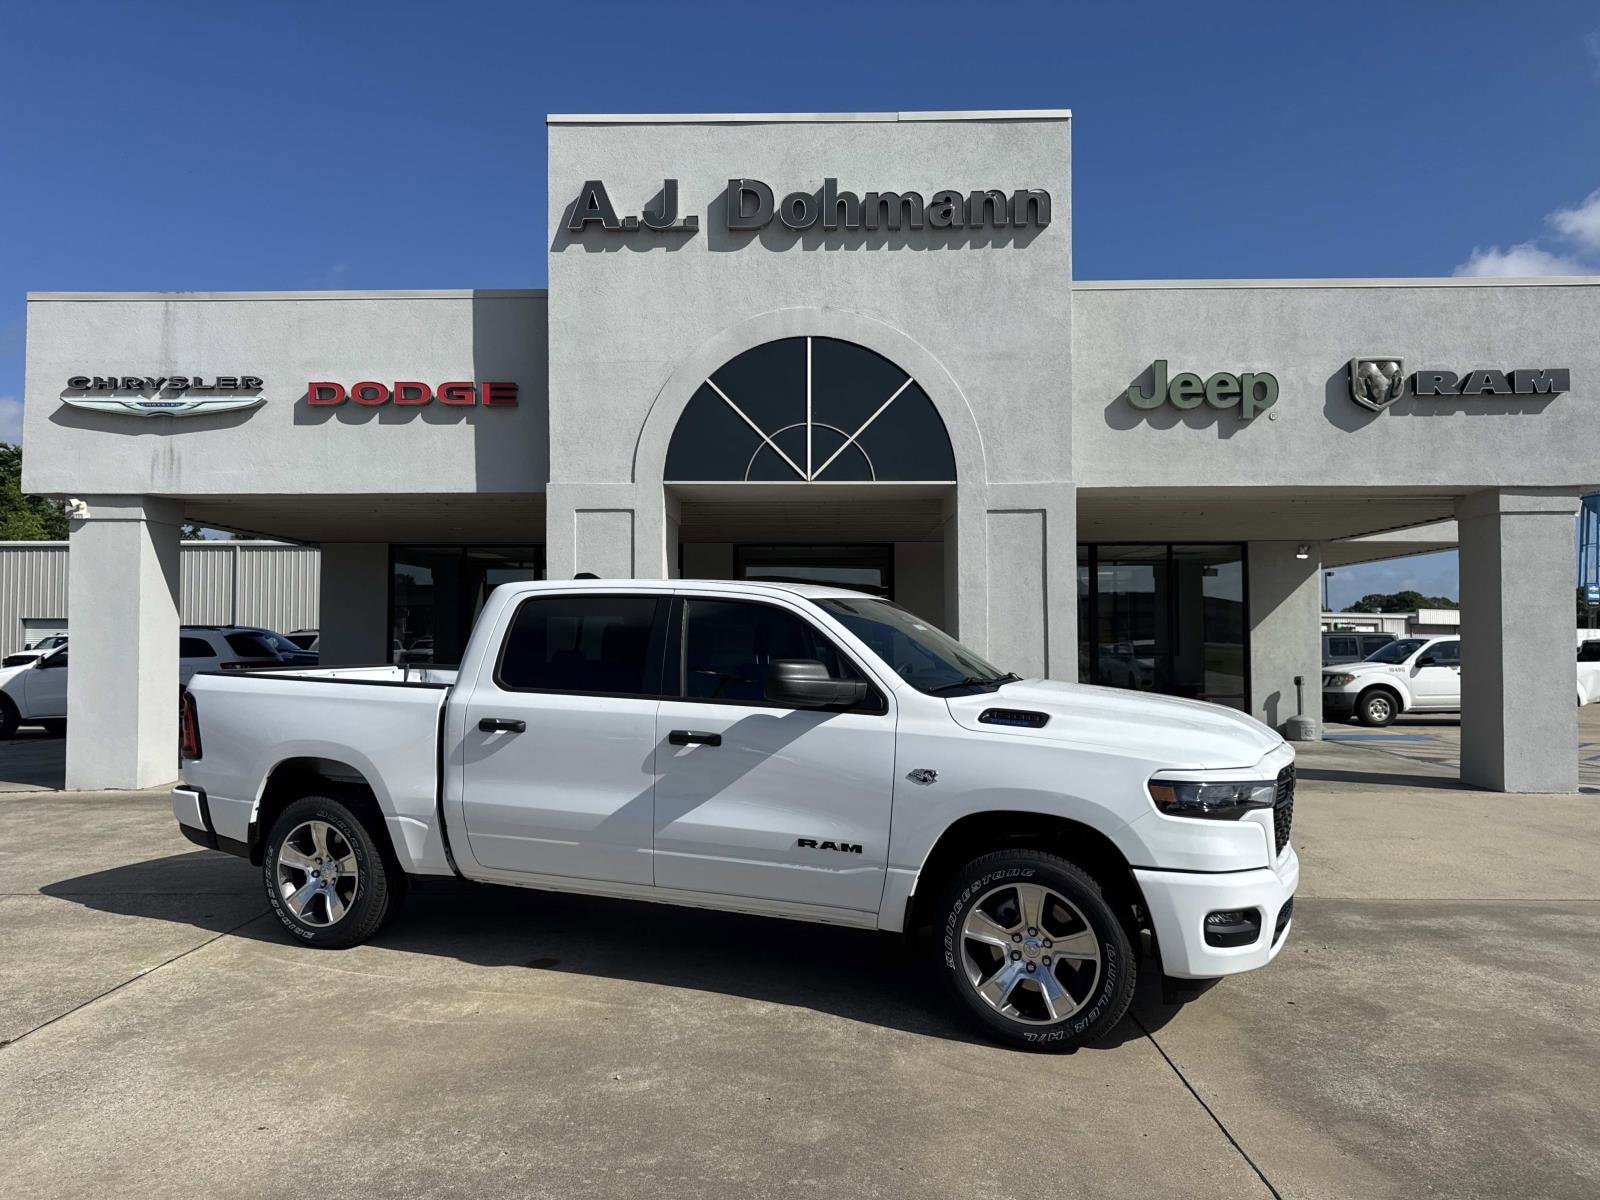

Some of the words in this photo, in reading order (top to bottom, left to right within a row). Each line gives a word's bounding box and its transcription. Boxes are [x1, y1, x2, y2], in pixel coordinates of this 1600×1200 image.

[567, 179, 699, 232] A.J.
[727, 177, 1052, 230] Dohmann
[66, 375, 264, 390] CHRYSLER
[308, 381, 519, 407] DODGE
[1128, 359, 1280, 419] Jeep
[1414, 368, 1571, 397] RAM
[797, 838, 863, 854] RAM
[944, 868, 1035, 970] BRIDGESTONE
[1074, 943, 1117, 1033] DUELER
